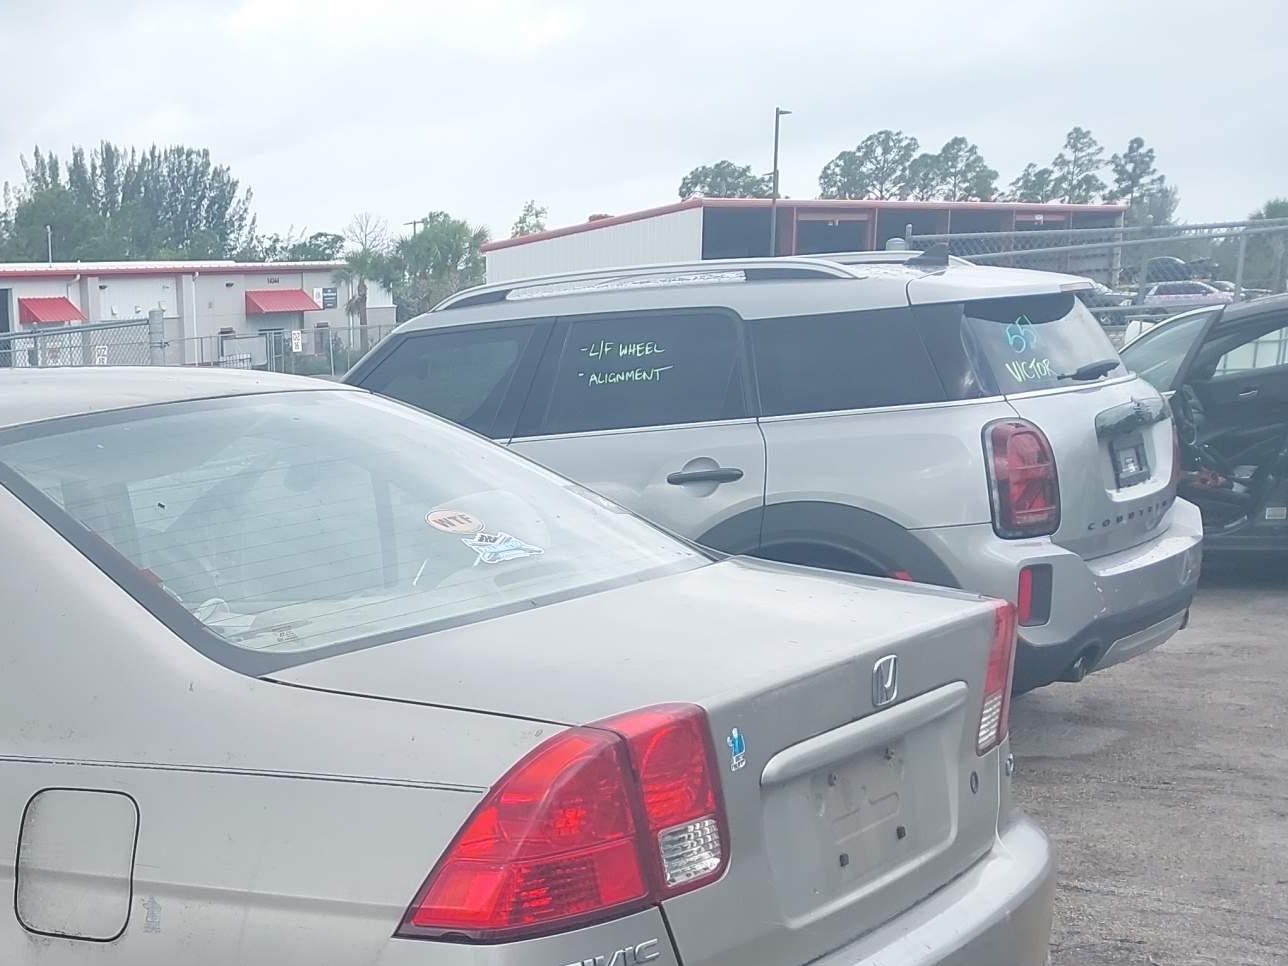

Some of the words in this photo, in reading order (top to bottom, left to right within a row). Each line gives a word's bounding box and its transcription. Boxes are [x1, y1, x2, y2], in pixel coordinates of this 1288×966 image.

[619, 342, 665, 357] WHEEL
[588, 366, 673, 387] ALIGNMENT
[1005, 357, 1057, 382] VICTOR
